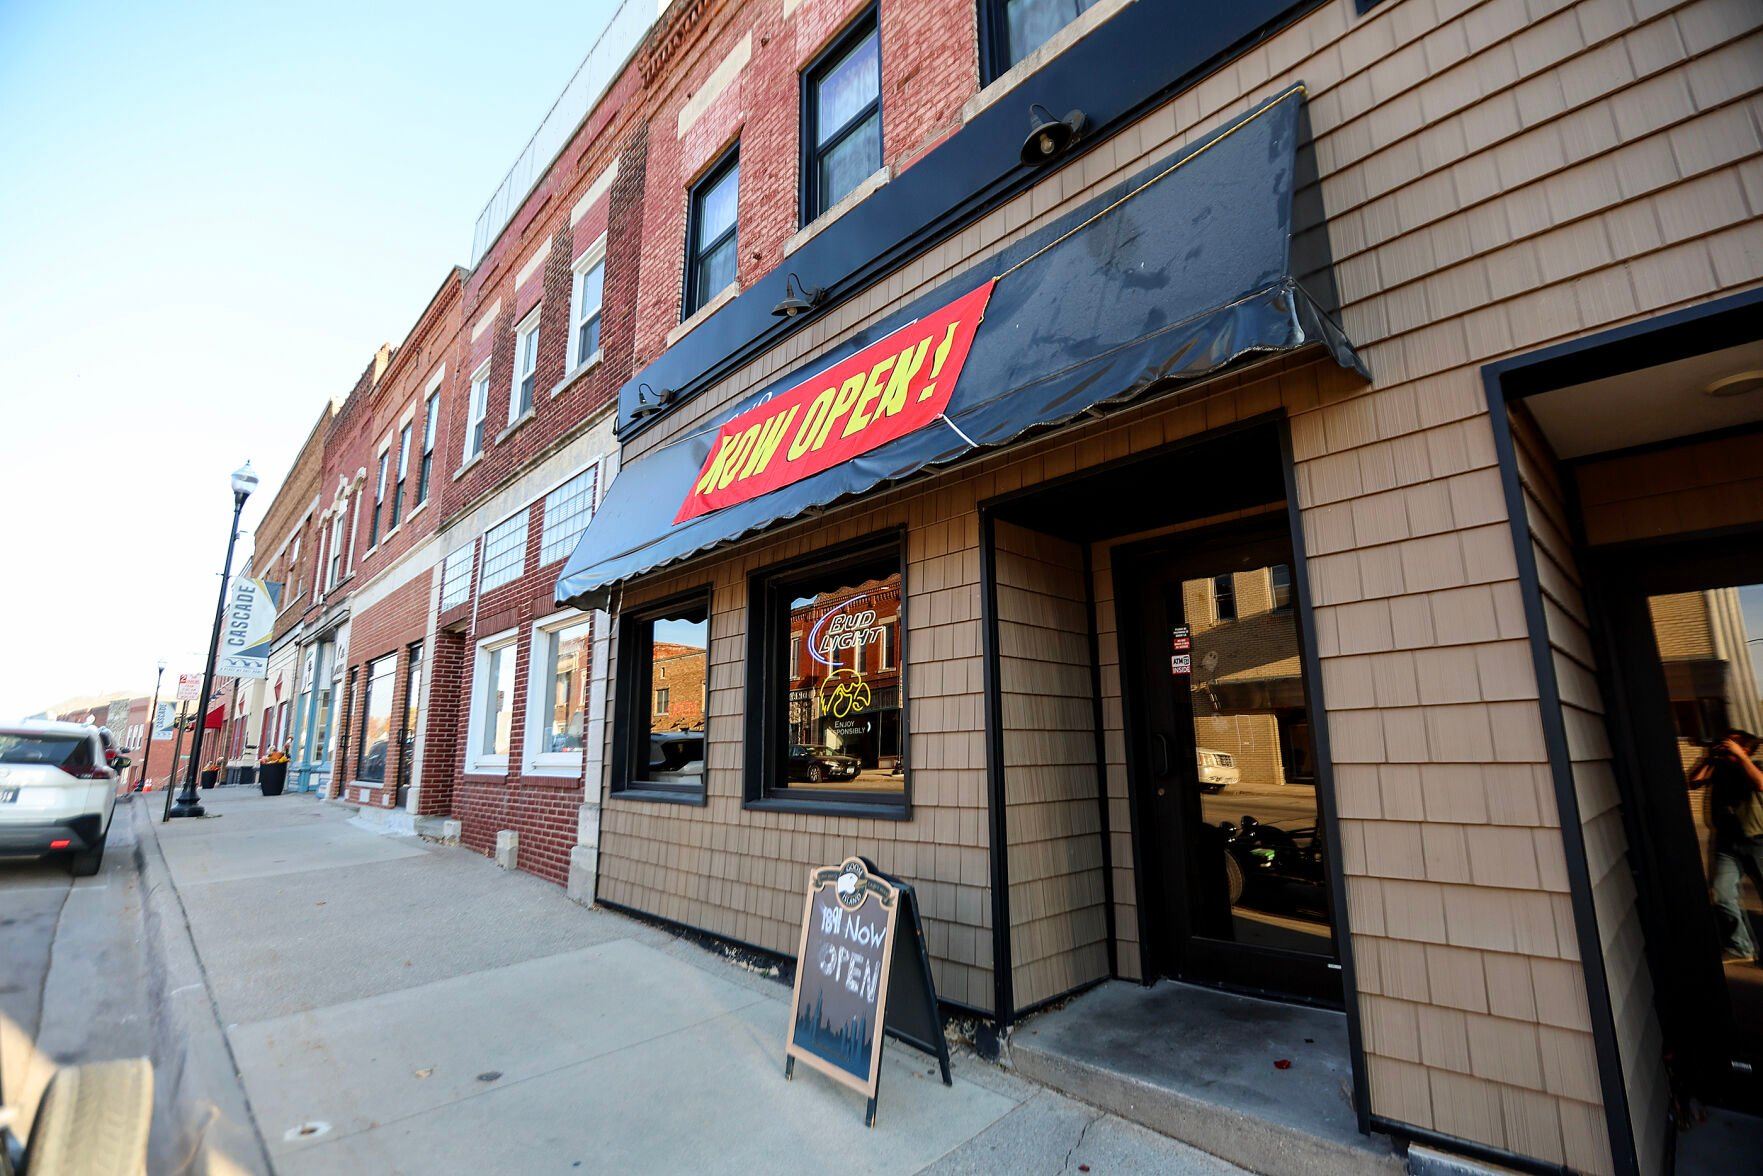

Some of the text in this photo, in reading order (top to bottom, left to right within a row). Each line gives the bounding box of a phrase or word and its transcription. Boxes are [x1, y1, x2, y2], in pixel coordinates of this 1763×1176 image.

[695, 321, 961, 497] NOW OPEN!
[227, 584, 256, 647] CASCADE
[828, 609, 876, 635] BUD
[818, 626, 884, 654] LIGHT
[1173, 666, 1190, 674] INSIDE
[824, 727, 866, 736] SPONSIBLY
[841, 891, 862, 906] ISLAND
[817, 941, 881, 1004] OPEN
